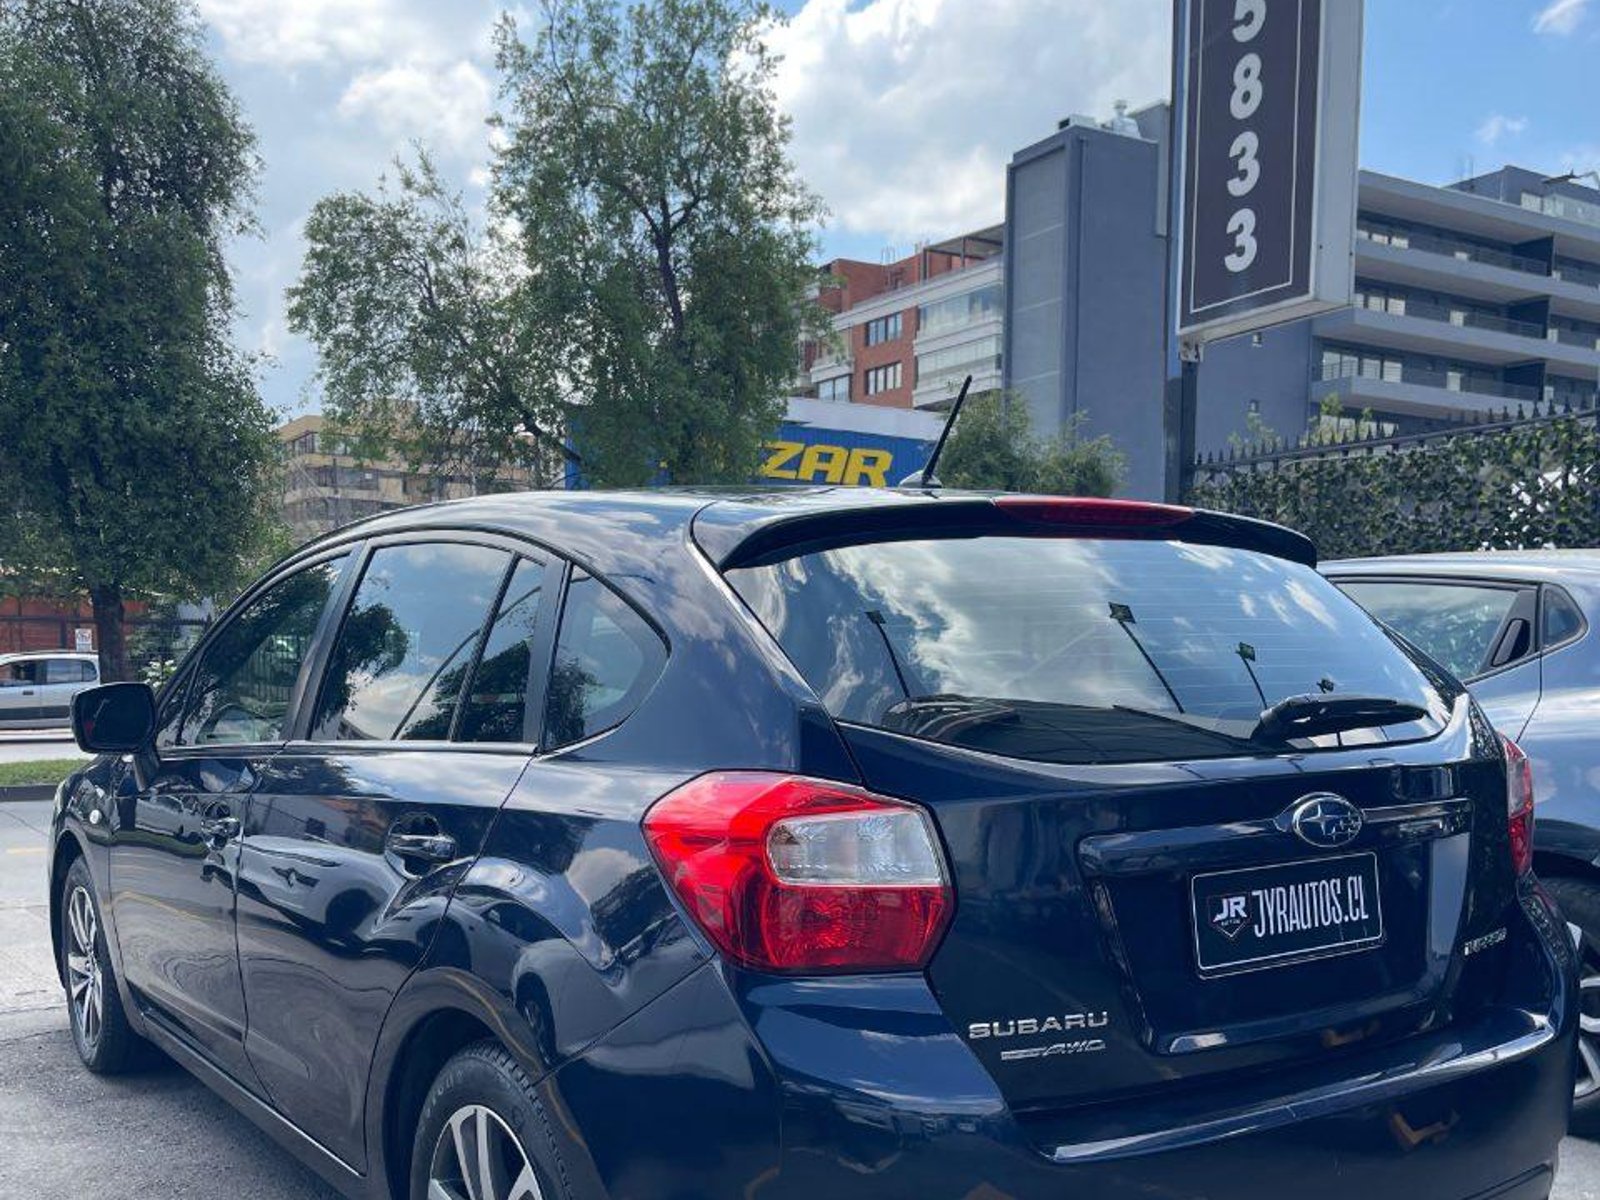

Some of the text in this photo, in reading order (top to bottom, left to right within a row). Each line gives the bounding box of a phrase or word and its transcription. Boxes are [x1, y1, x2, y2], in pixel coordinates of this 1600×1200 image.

[758, 441, 893, 487] ZAR
[1212, 875, 1369, 938] JR JYRAUTOS.CL
[968, 1011, 1108, 1039] SUBARU
